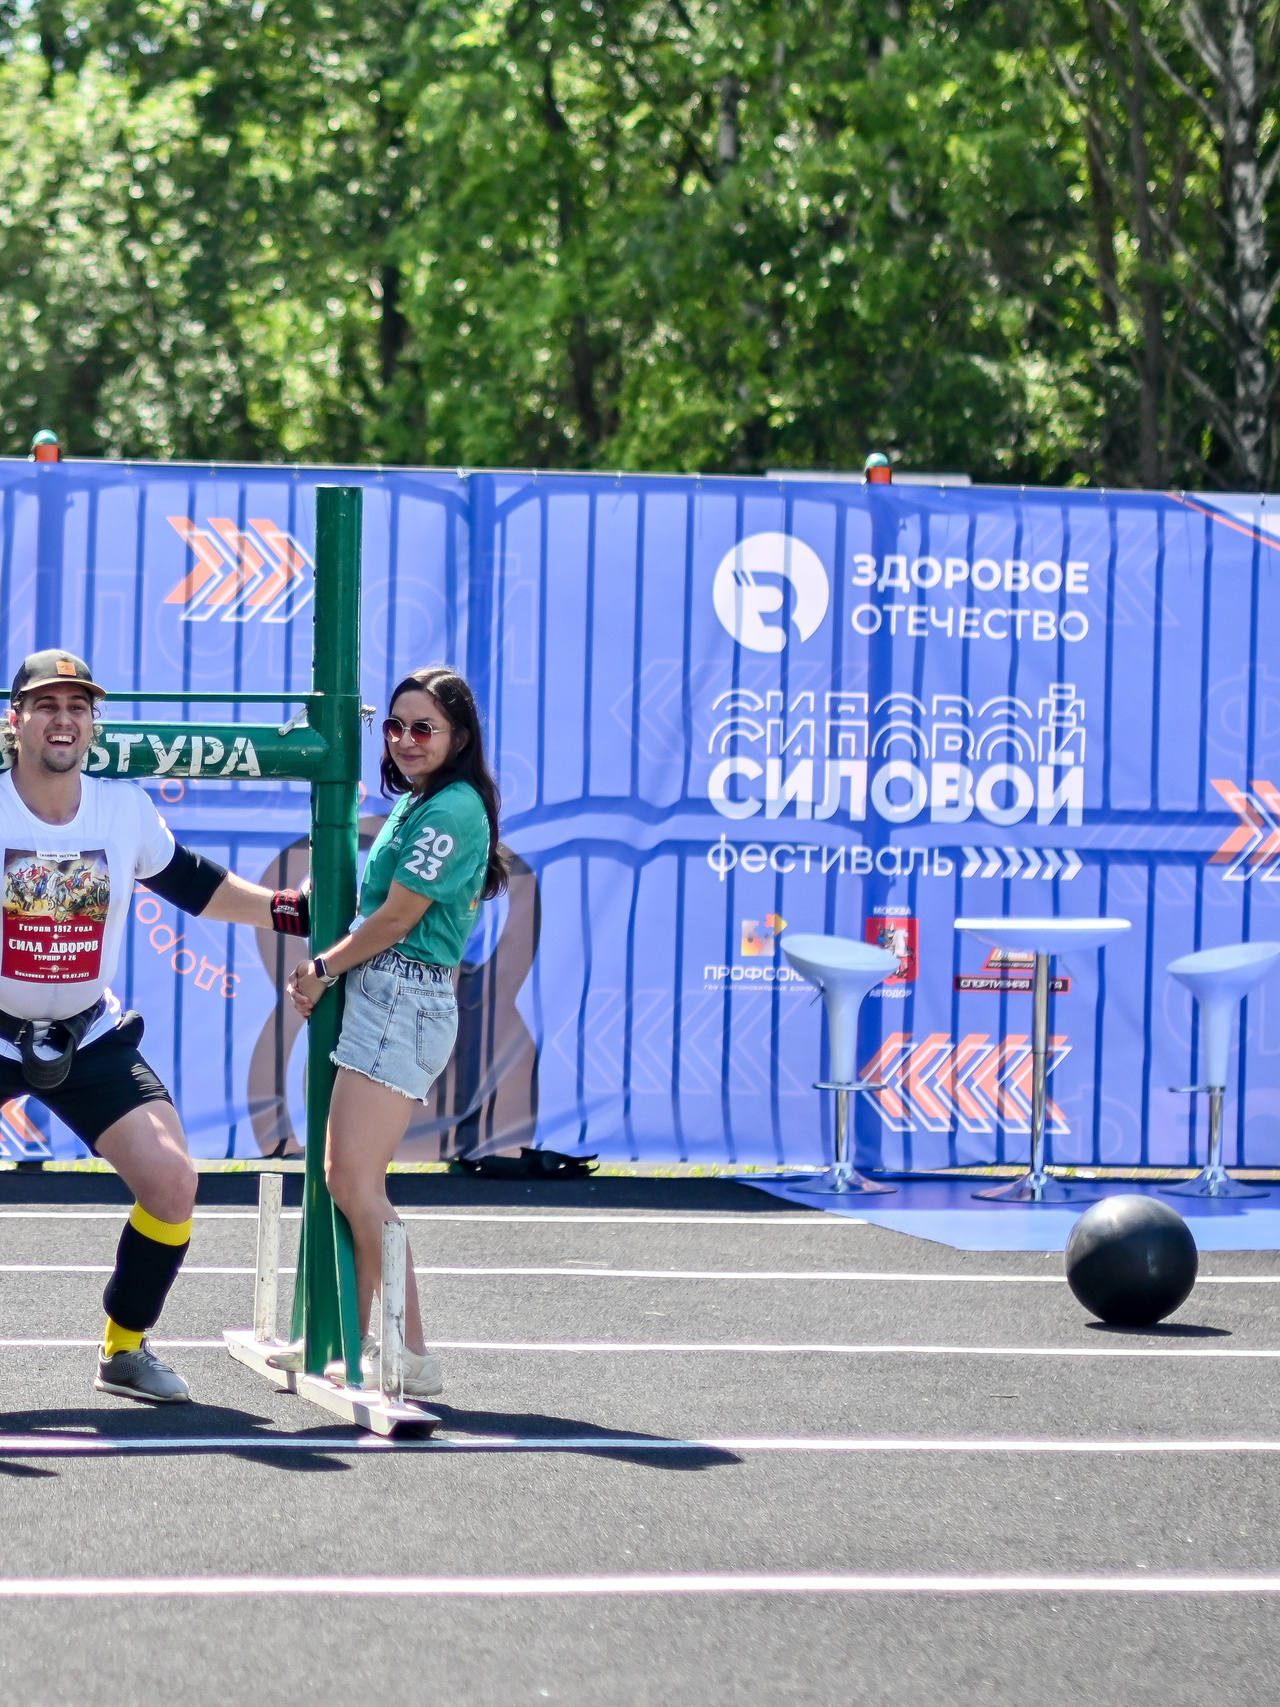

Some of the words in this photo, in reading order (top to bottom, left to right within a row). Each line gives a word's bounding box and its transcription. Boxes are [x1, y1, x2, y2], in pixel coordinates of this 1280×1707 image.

[852, 554, 1089, 594] ЗДОРОВОЕ
[852, 603, 1089, 643] ОТЕЧЕСТВО
[707, 751, 1084, 827] СИЛОВОЙ
[414, 827, 454, 858] 20
[707, 834, 954, 881] фестиваль
[404, 850, 443, 881] 23
[873, 906, 911, 916] МОСКВА
[53, 925, 72, 933] 1812
[8, 938, 43, 953] СИЛА
[49, 940, 99, 954] ДВОРОВ
[704, 966, 806, 982] ПРОФСОЮ
